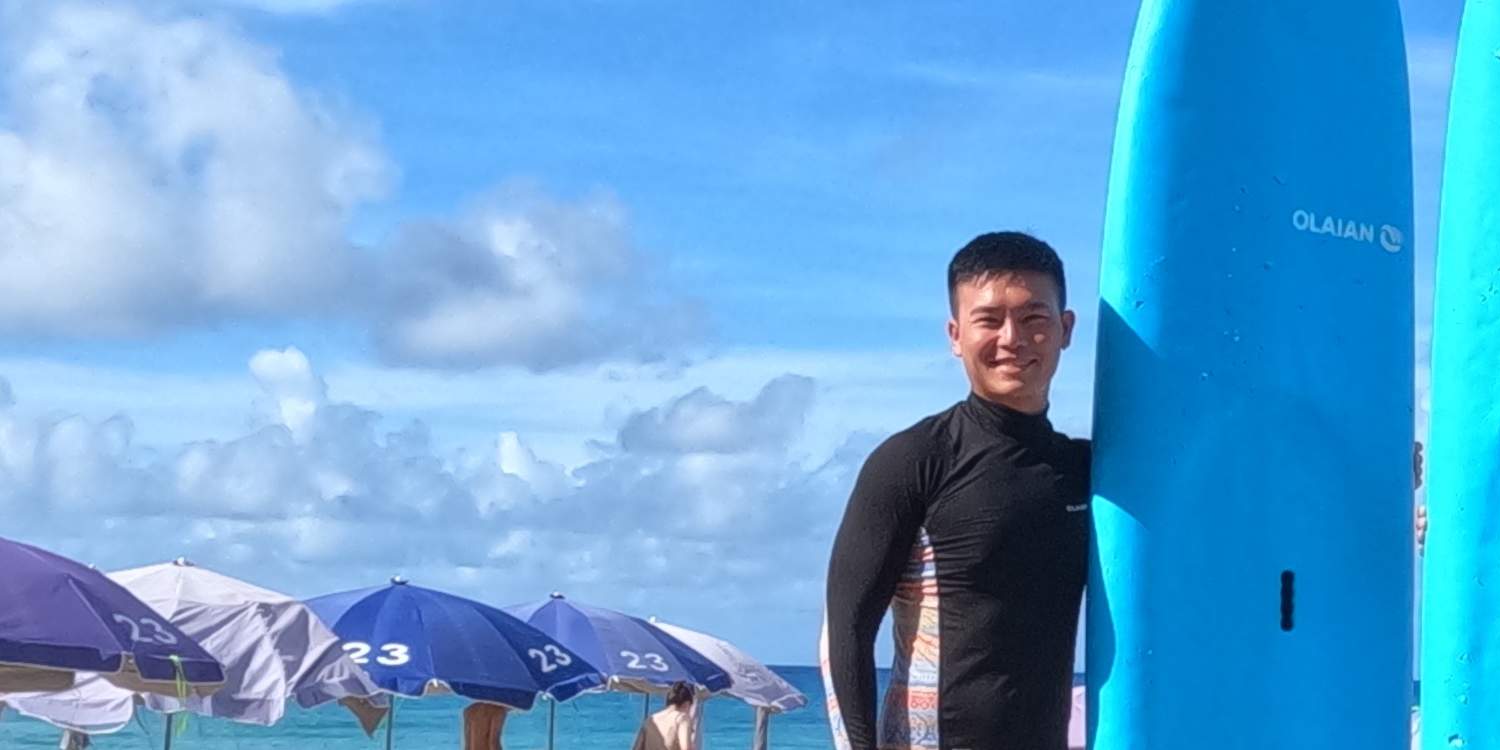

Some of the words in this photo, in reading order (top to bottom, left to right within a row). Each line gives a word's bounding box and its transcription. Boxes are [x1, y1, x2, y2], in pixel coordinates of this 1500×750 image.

[1293, 209, 1375, 243] OLAIAN
[112, 613, 178, 645] 23
[341, 641, 411, 666] 23
[528, 644, 572, 673] 23
[620, 650, 669, 672] 23
